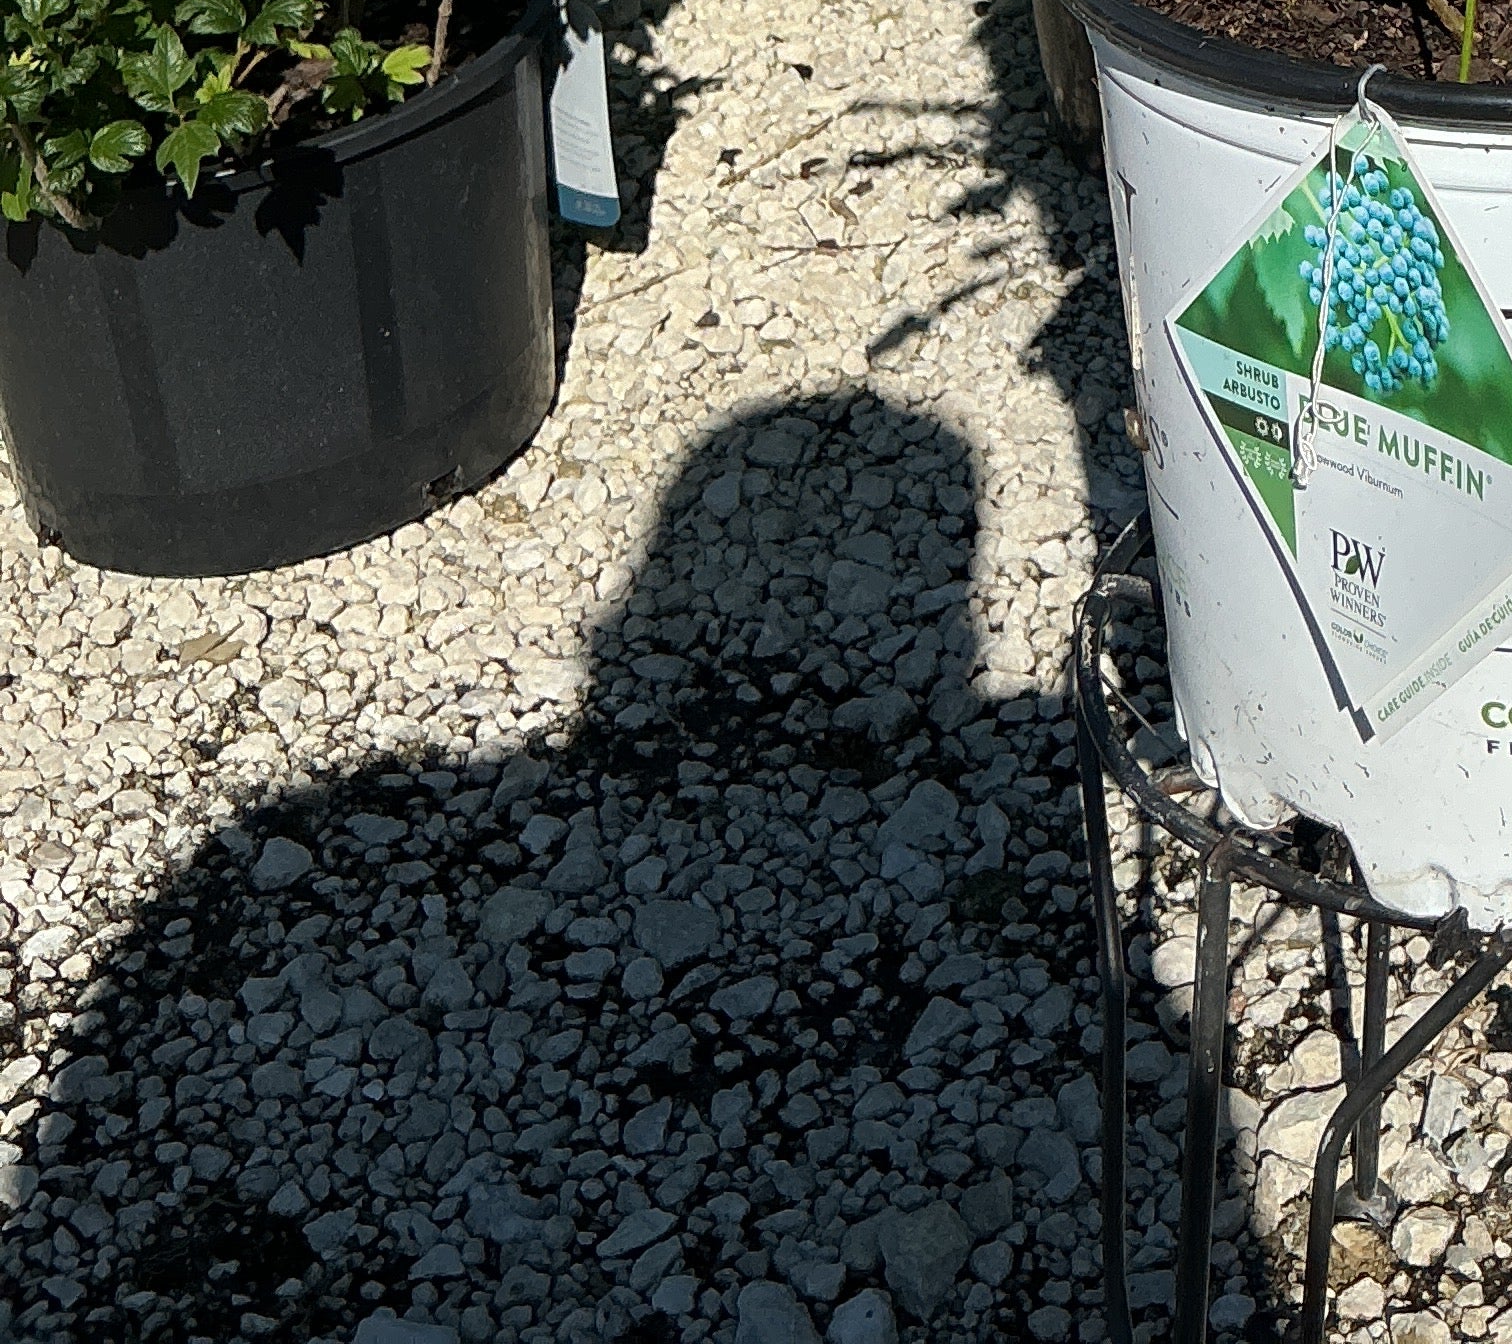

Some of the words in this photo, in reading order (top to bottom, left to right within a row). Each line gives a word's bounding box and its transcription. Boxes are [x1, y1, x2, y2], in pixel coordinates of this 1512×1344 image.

[1236, 360, 1280, 390] SHRUB
[1222, 377, 1281, 411] ARBUSTO
[1356, 466, 1404, 500] Viburnum
[1329, 527, 1386, 590] PW
[1330, 587, 1387, 628] WINNERS
[1334, 572, 1380, 608] PROVEN
[1377, 697, 1401, 723] CARE
[1399, 676, 1426, 705] GUIDE
[1423, 652, 1453, 684] INSIDE
[1478, 618, 1494, 637] DE
